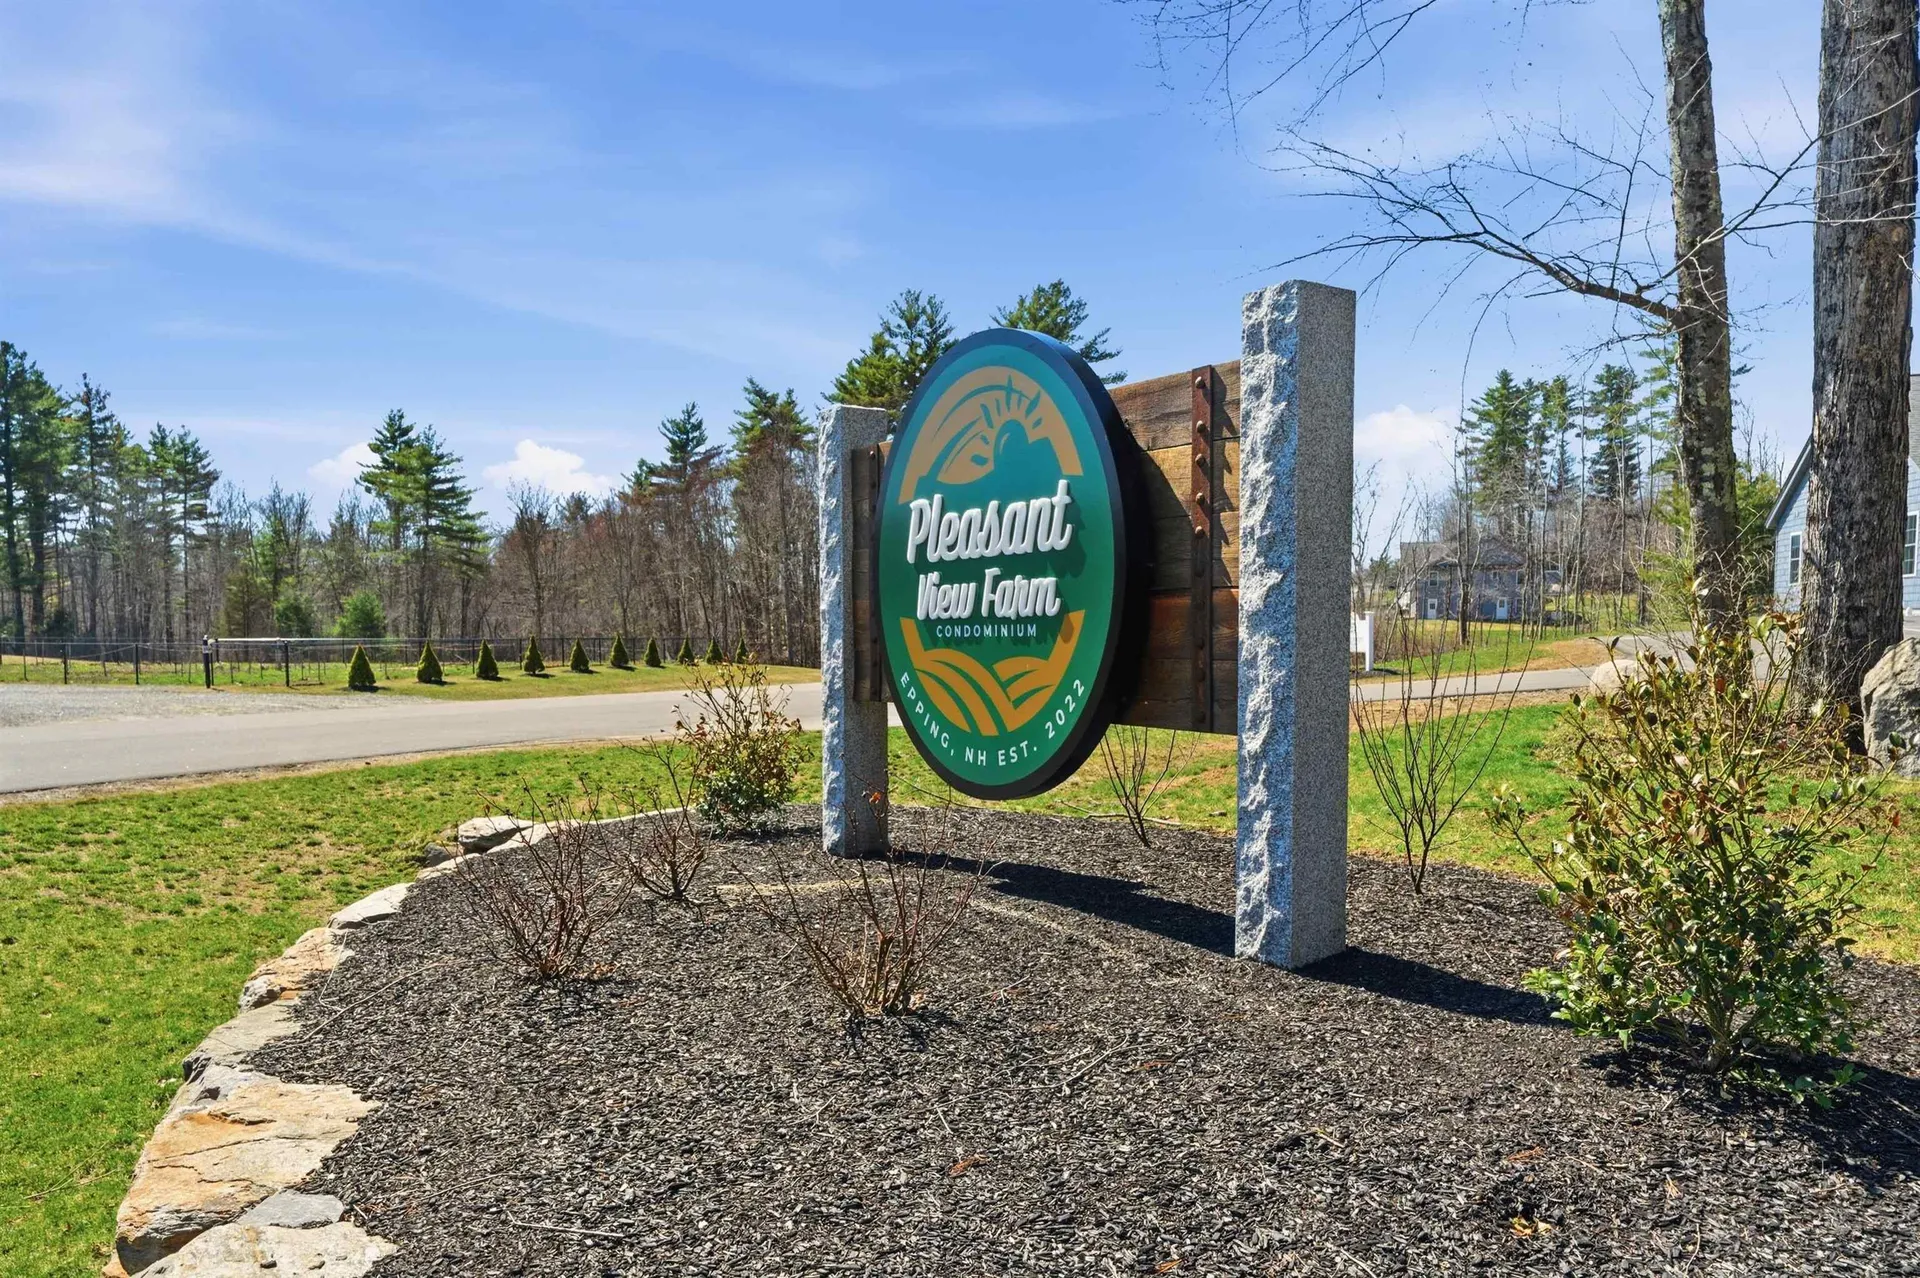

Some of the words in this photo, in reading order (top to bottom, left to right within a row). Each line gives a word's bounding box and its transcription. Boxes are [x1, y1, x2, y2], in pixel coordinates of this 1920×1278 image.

[906, 479, 1073, 564] Pleasant
[916, 571, 977, 621] View
[981, 567, 1061, 620] Farm
[936, 624, 1037, 638] CONDOMINIUM
[900, 671, 955, 756] EPPING,
[964, 746, 987, 766] NH
[998, 740, 1037, 766] EST.
[1044, 679, 1085, 740] 2022
